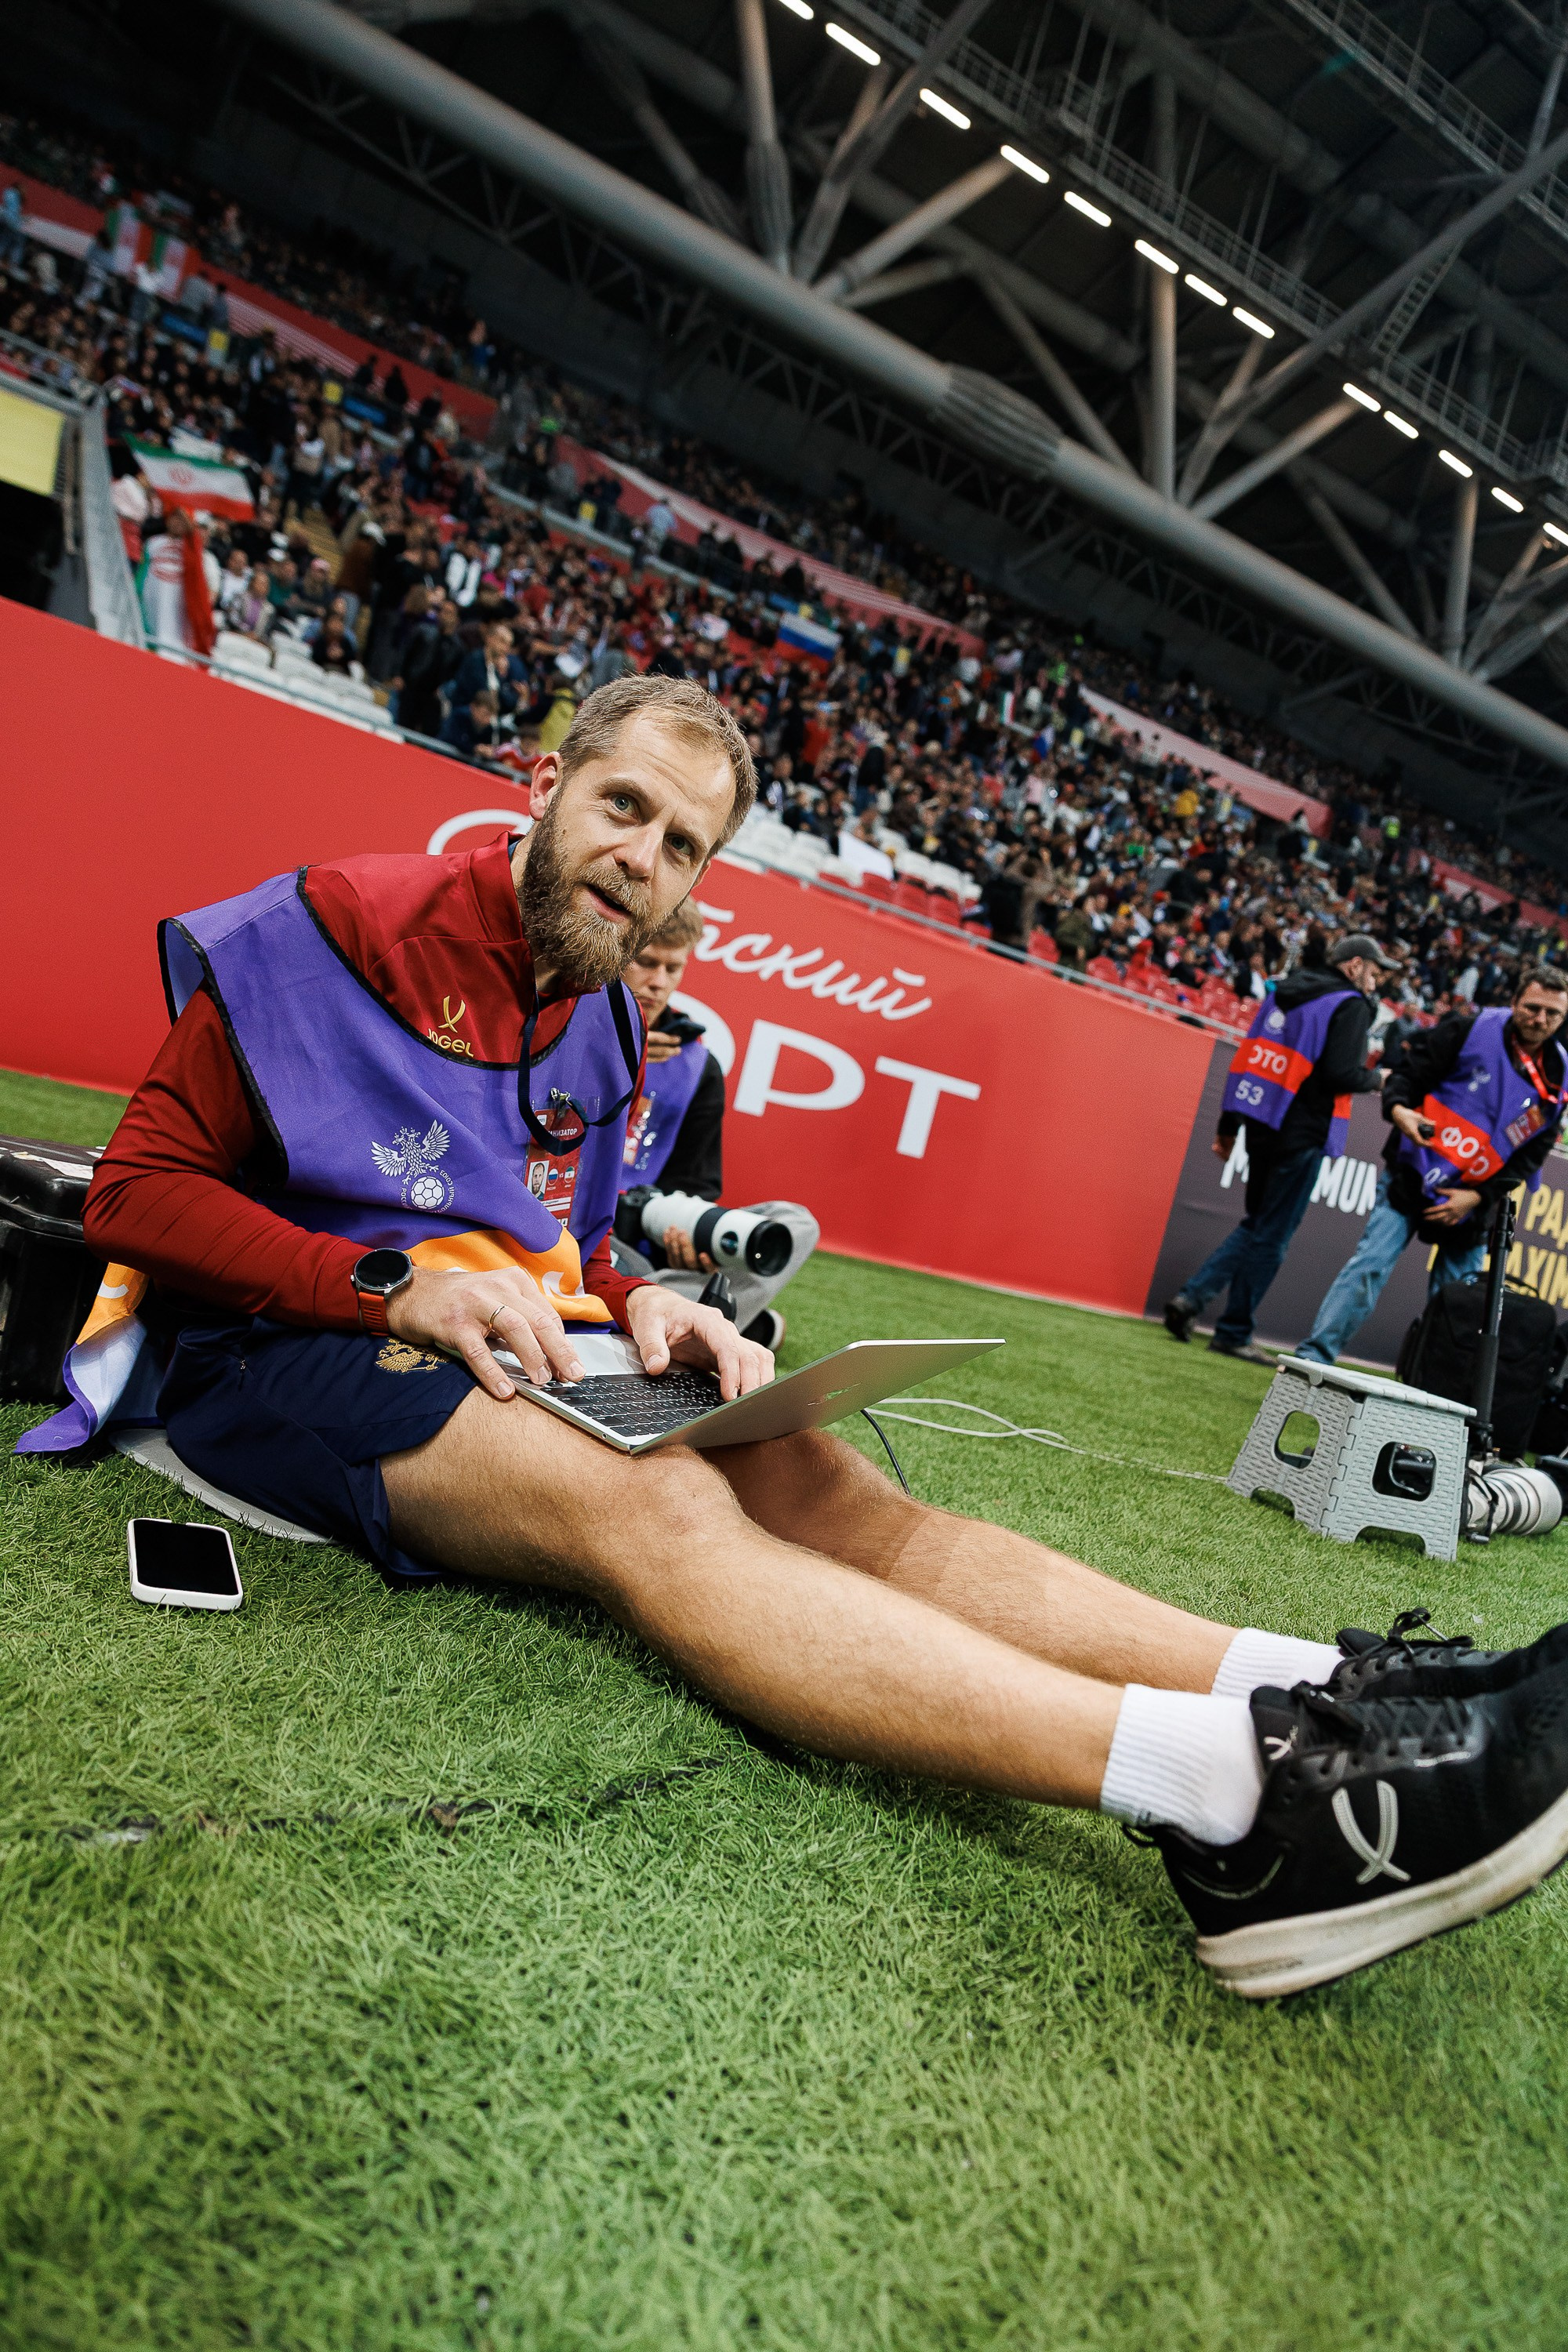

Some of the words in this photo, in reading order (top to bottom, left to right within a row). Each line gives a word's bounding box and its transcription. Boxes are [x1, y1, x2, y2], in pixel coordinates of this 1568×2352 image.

[695, 901, 933, 1021] йский
[1235, 1079, 1265, 1106] 53
[1440, 1126, 1490, 1177] ФОО
